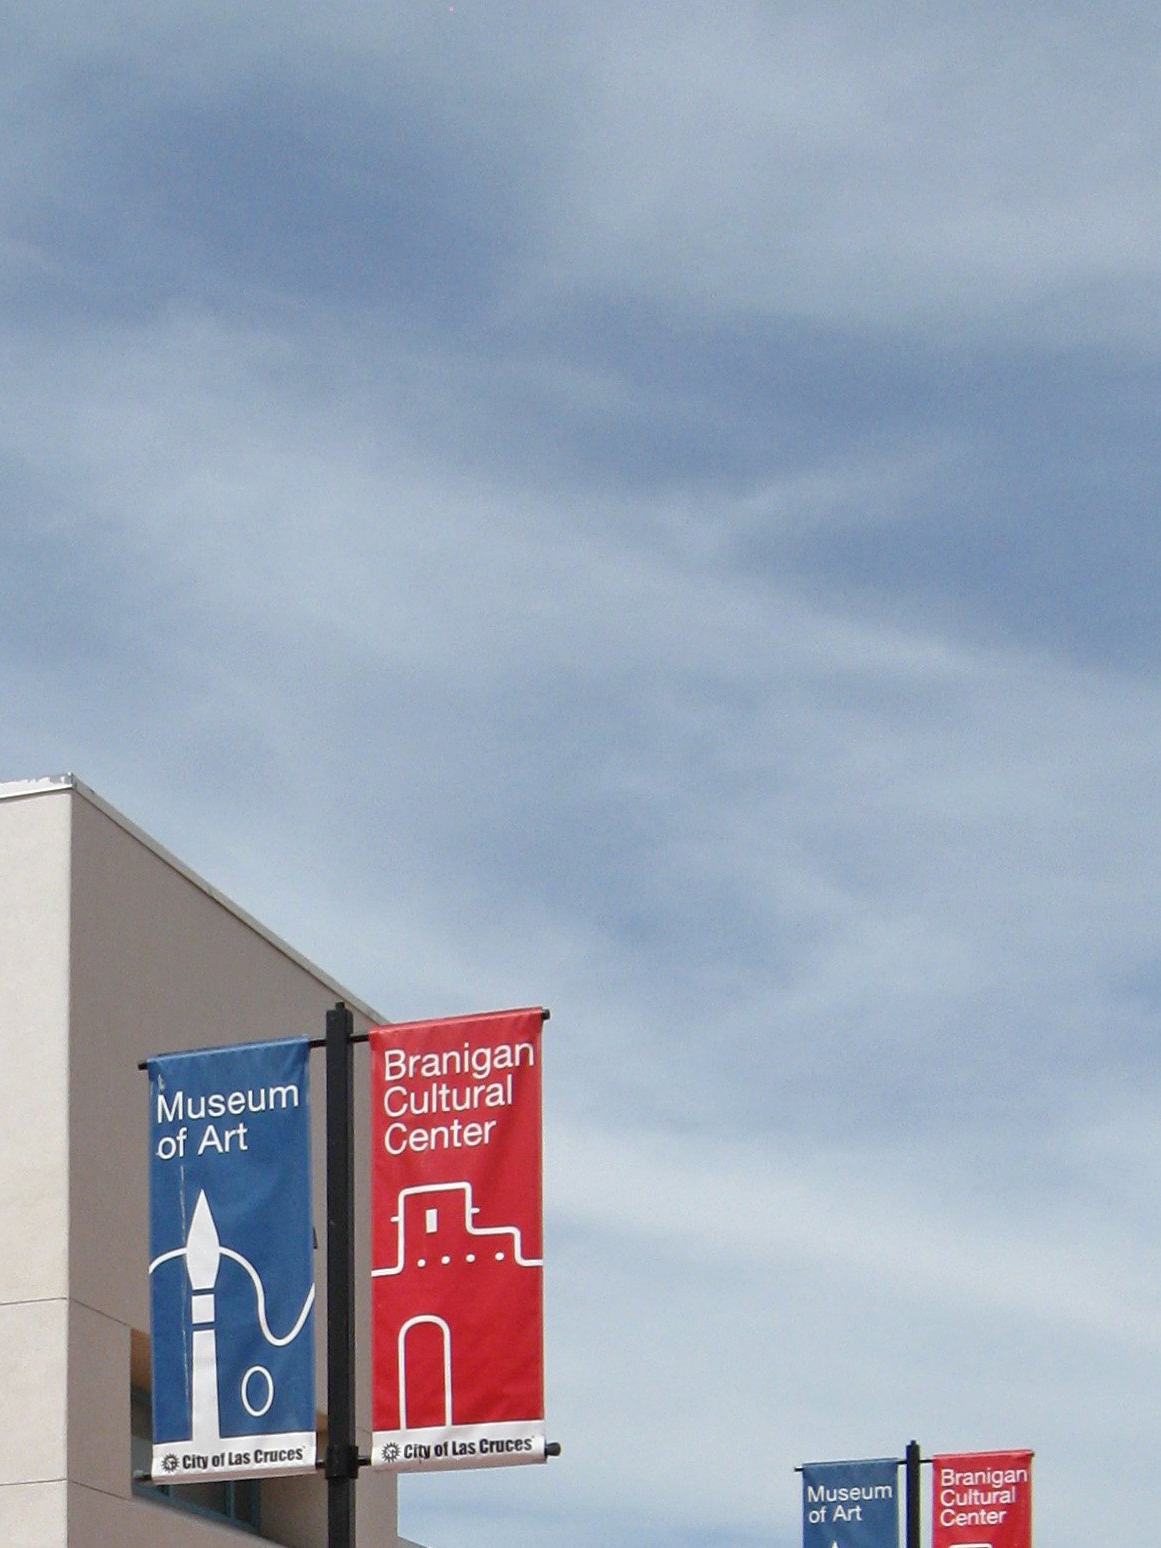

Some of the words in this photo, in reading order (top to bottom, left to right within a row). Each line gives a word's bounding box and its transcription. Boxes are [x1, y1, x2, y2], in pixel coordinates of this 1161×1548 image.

[384, 1042, 534, 1081] Branigan
[157, 1084, 299, 1123] Museum
[384, 1074, 513, 1117] Cultural
[157, 1127, 187, 1160] of
[197, 1122, 248, 1155] Art
[384, 1119, 497, 1155] Center
[182, 1454, 208, 1470] City
[212, 1452, 225, 1467] of
[228, 1451, 251, 1466] Las
[254, 1448, 303, 1464] Cruces
[403, 1443, 431, 1459] City
[434, 1441, 448, 1457] of
[452, 1440, 476, 1456] Las
[479, 1438, 532, 1454] Cruces
[941, 1467, 1028, 1488] Branigan
[807, 1484, 892, 1503] Museum
[940, 1486, 1016, 1508] Cultural
[809, 1505, 827, 1523] of
[832, 1504, 862, 1522] Art
[940, 1508, 1006, 1527] Center
